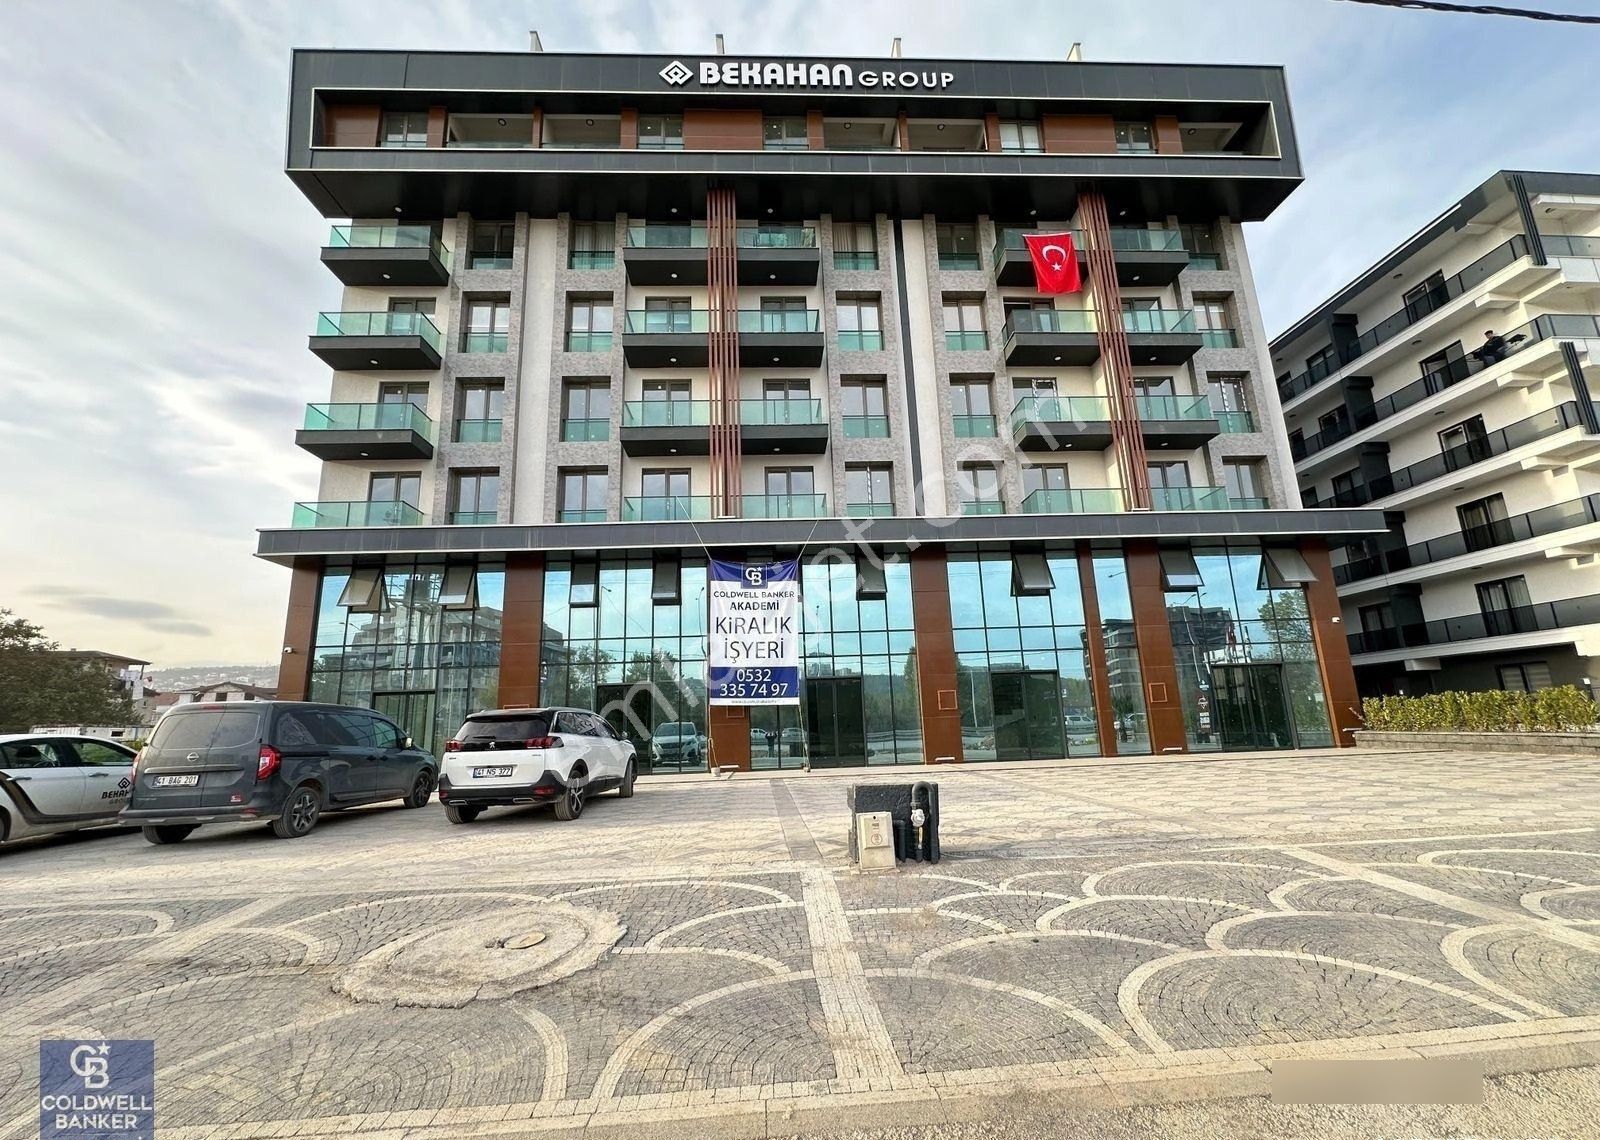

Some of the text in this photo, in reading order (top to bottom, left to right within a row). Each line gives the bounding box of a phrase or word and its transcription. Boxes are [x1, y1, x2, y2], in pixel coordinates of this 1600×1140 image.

[700, 62, 954, 88] BEKAHAN GROUP
[713, 590, 795, 599] COLDWELL BANKER
[729, 600, 780, 611] AKADEMİ
[724, 637, 784, 664] İŞYERİ
[736, 668, 772, 682] 0532
[719, 682, 788, 696] 335 74 97
